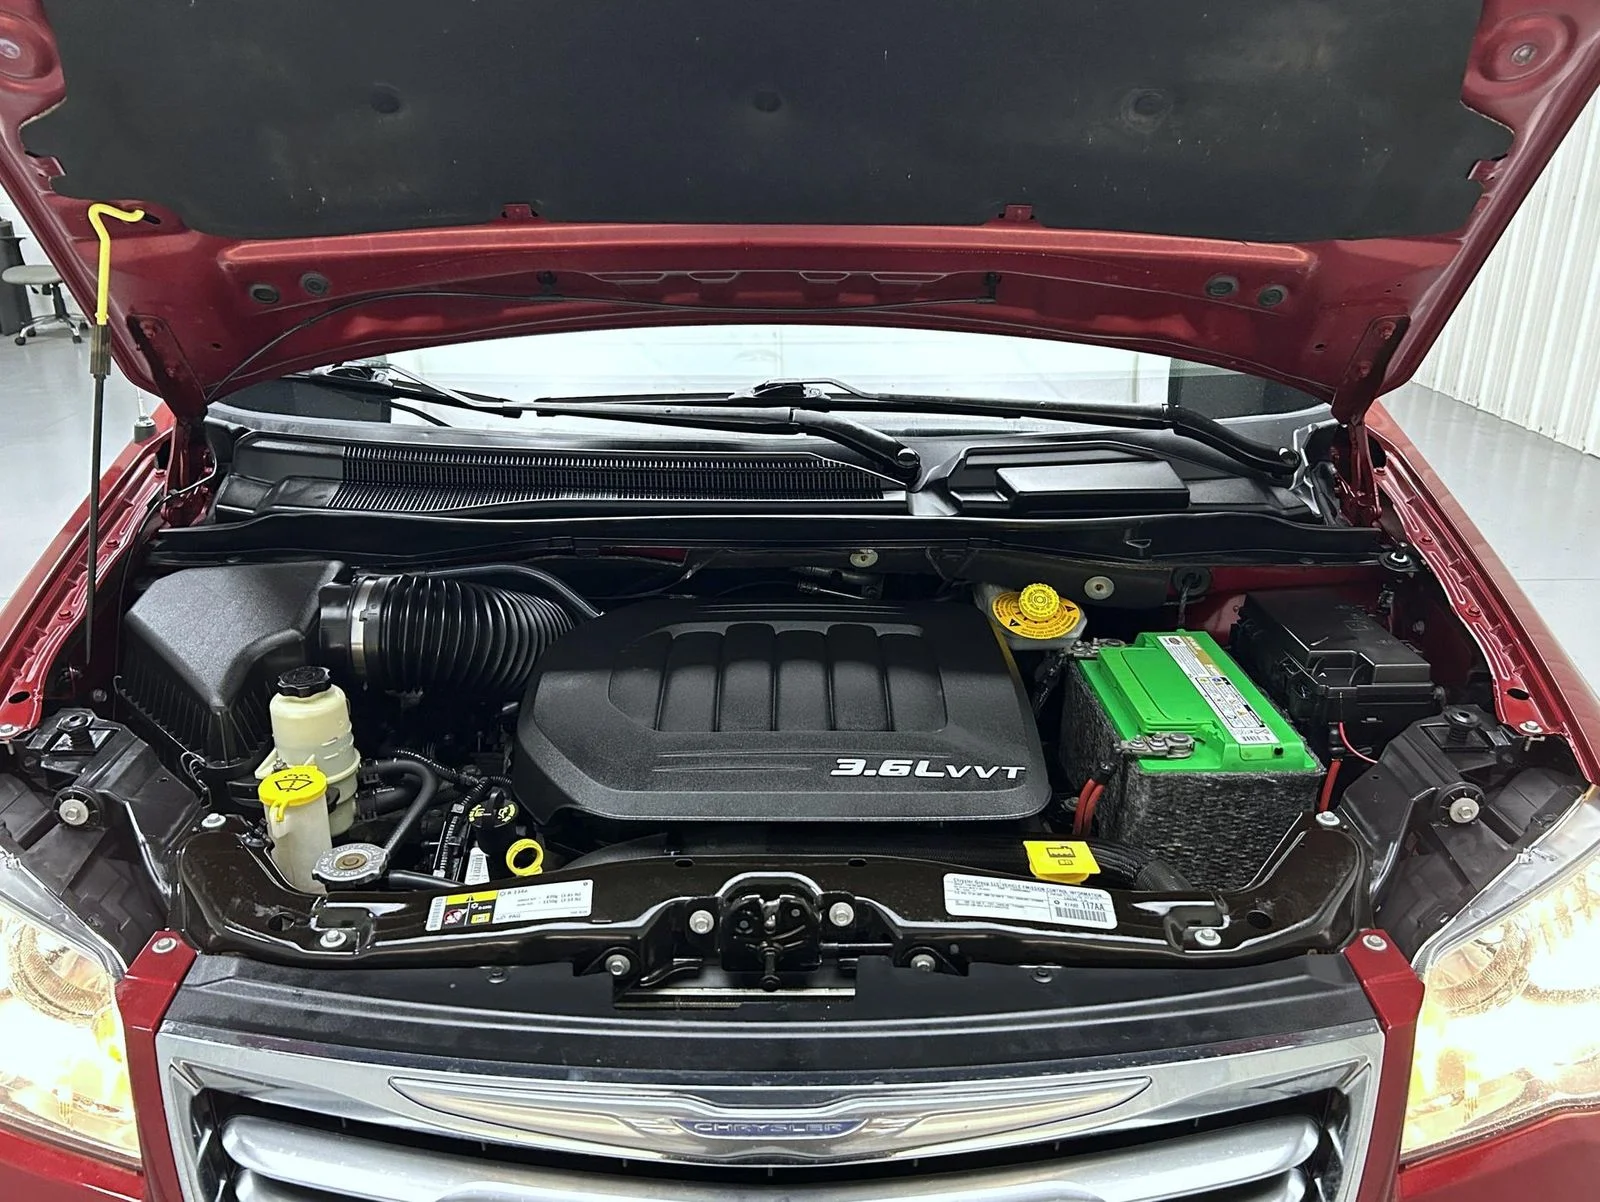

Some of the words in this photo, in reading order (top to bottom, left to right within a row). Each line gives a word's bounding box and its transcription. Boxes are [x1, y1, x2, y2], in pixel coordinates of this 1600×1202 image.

[830, 758, 945, 777] 3.6L
[945, 764, 1026, 779] VVT
[694, 1122, 843, 1133] CHRYSLER
